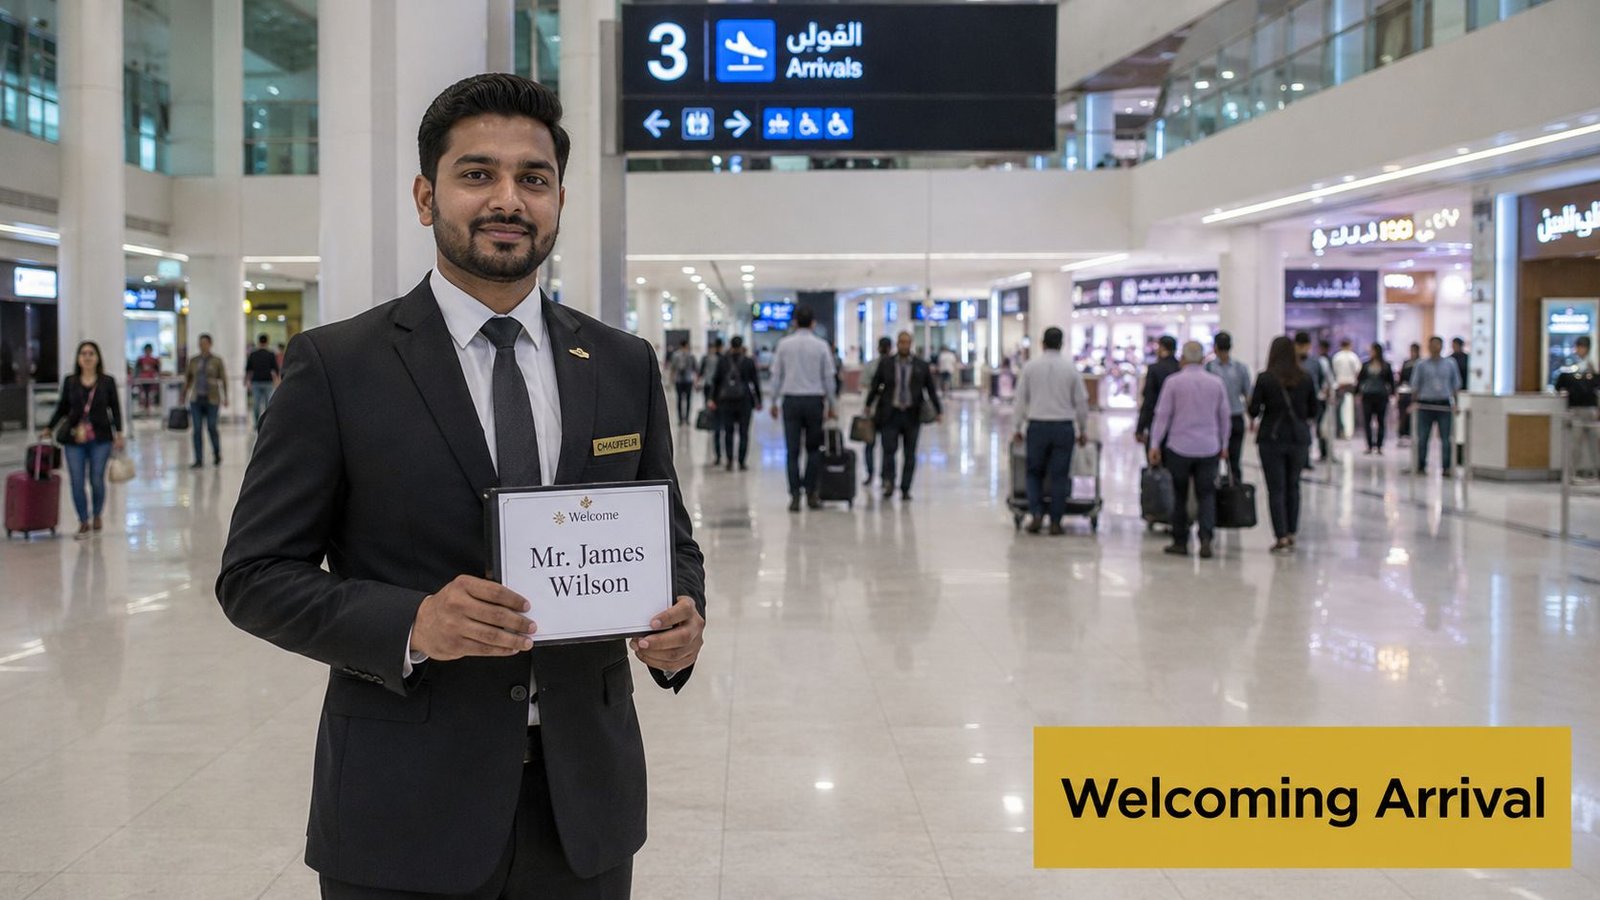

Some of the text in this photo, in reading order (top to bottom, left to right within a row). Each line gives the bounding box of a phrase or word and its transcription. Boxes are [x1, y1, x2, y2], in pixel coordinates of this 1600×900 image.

[647, 22, 688, 81] 3
[785, 56, 863, 79] Arrivals
[568, 510, 619, 523] Welcome
[530, 543, 645, 569] Mr. James
[549, 573, 630, 598] Wilson
